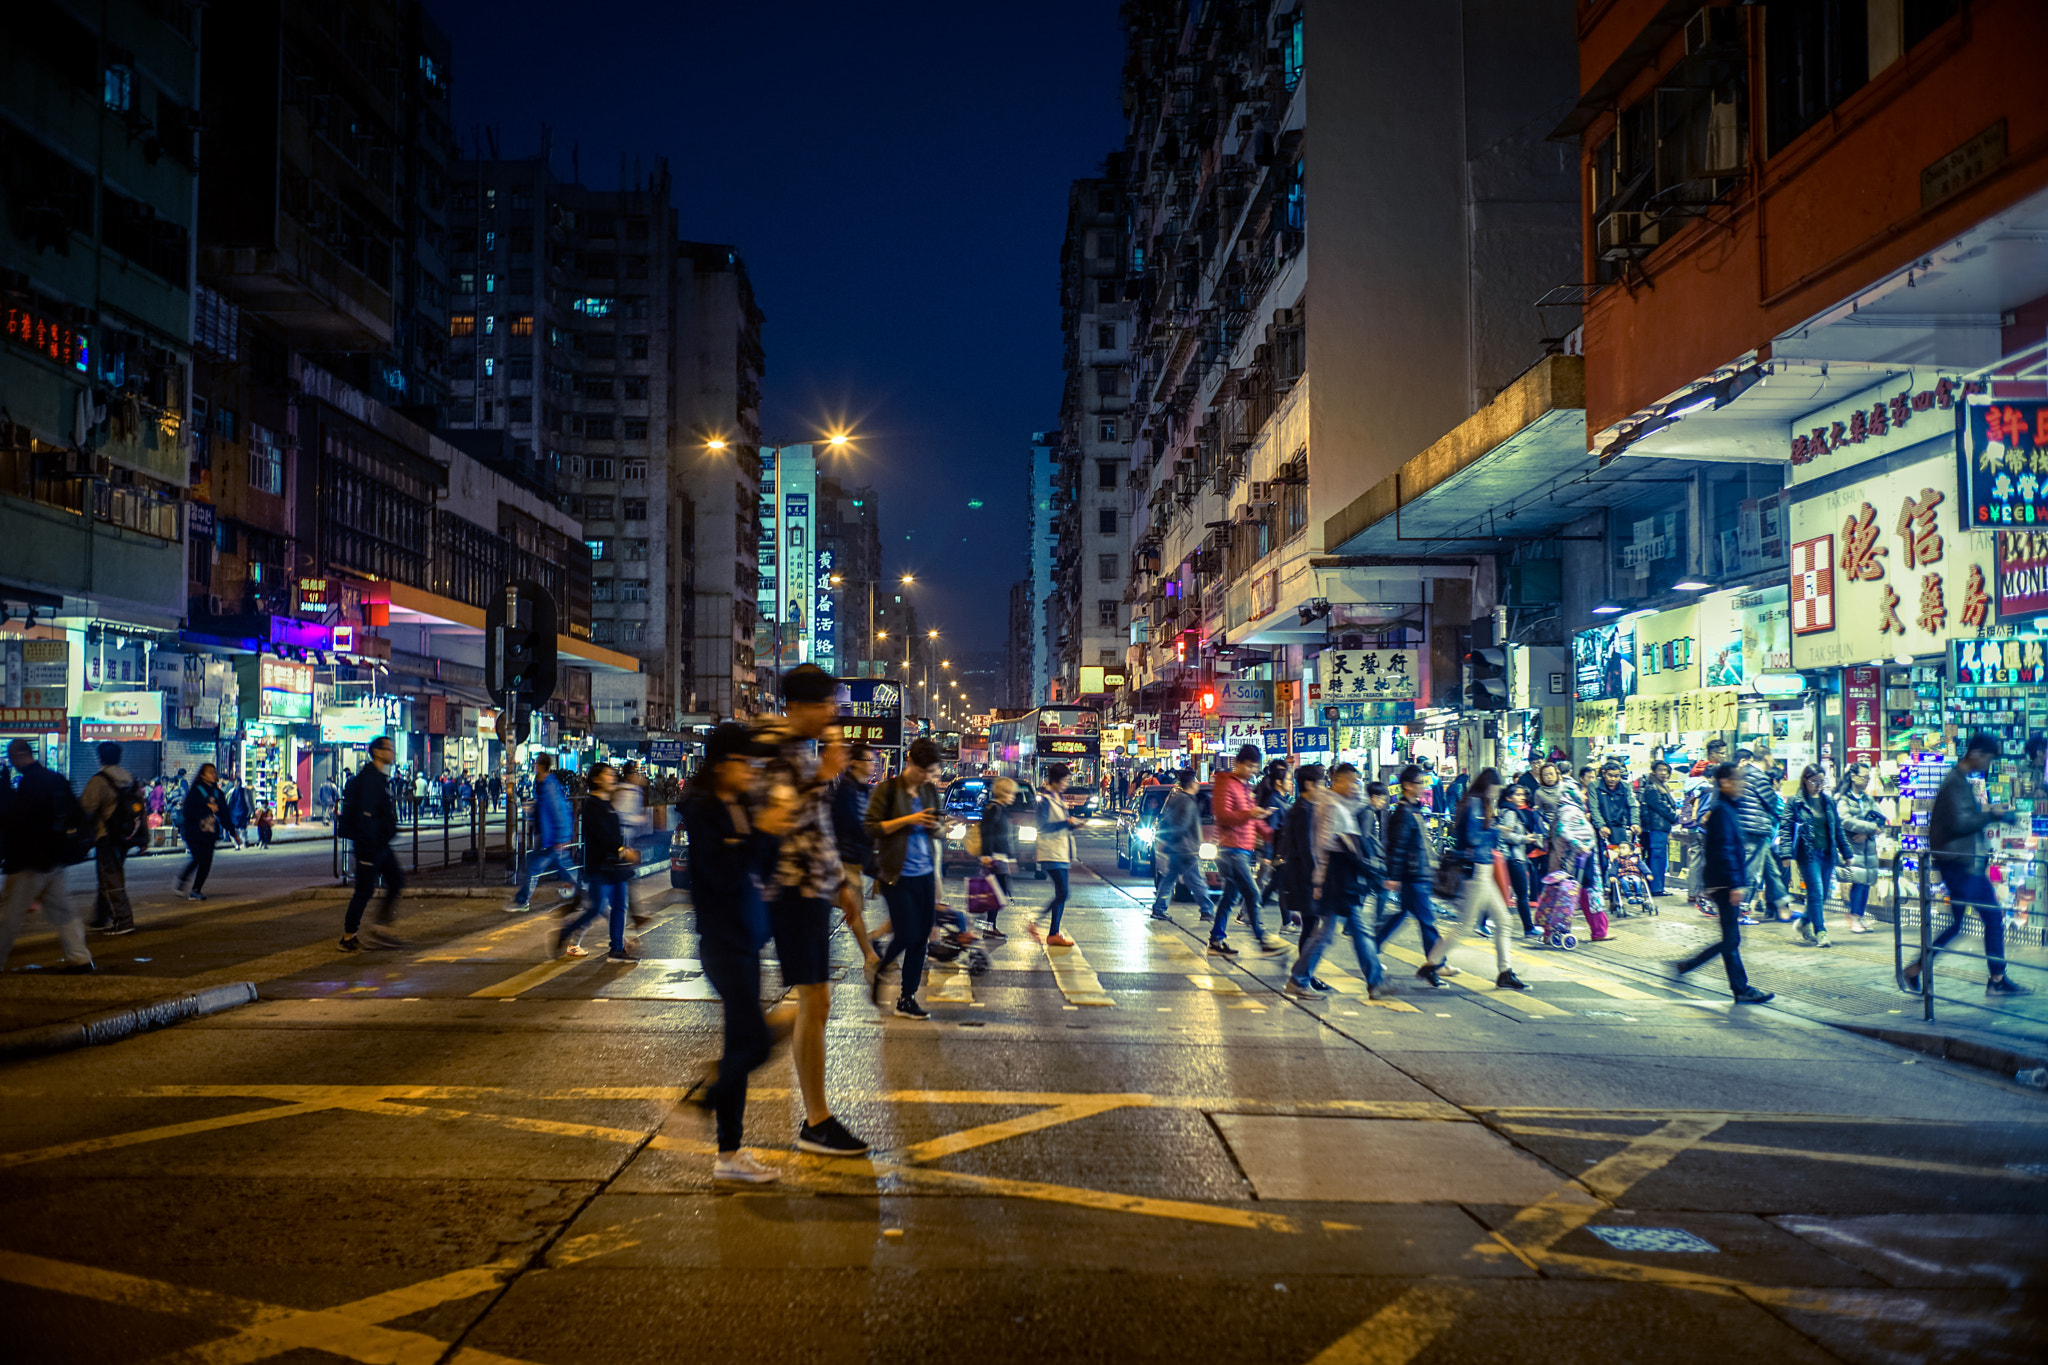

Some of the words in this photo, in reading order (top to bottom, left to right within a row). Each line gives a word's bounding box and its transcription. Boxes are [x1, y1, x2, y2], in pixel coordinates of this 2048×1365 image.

[1878, 563, 1993, 635] 大藥房
[1332, 652, 1409, 675] 天藝行
[1222, 682, 1266, 699] A-Salon
[867, 726, 883, 739] 112
[1229, 738, 1260, 746] BROTHER
